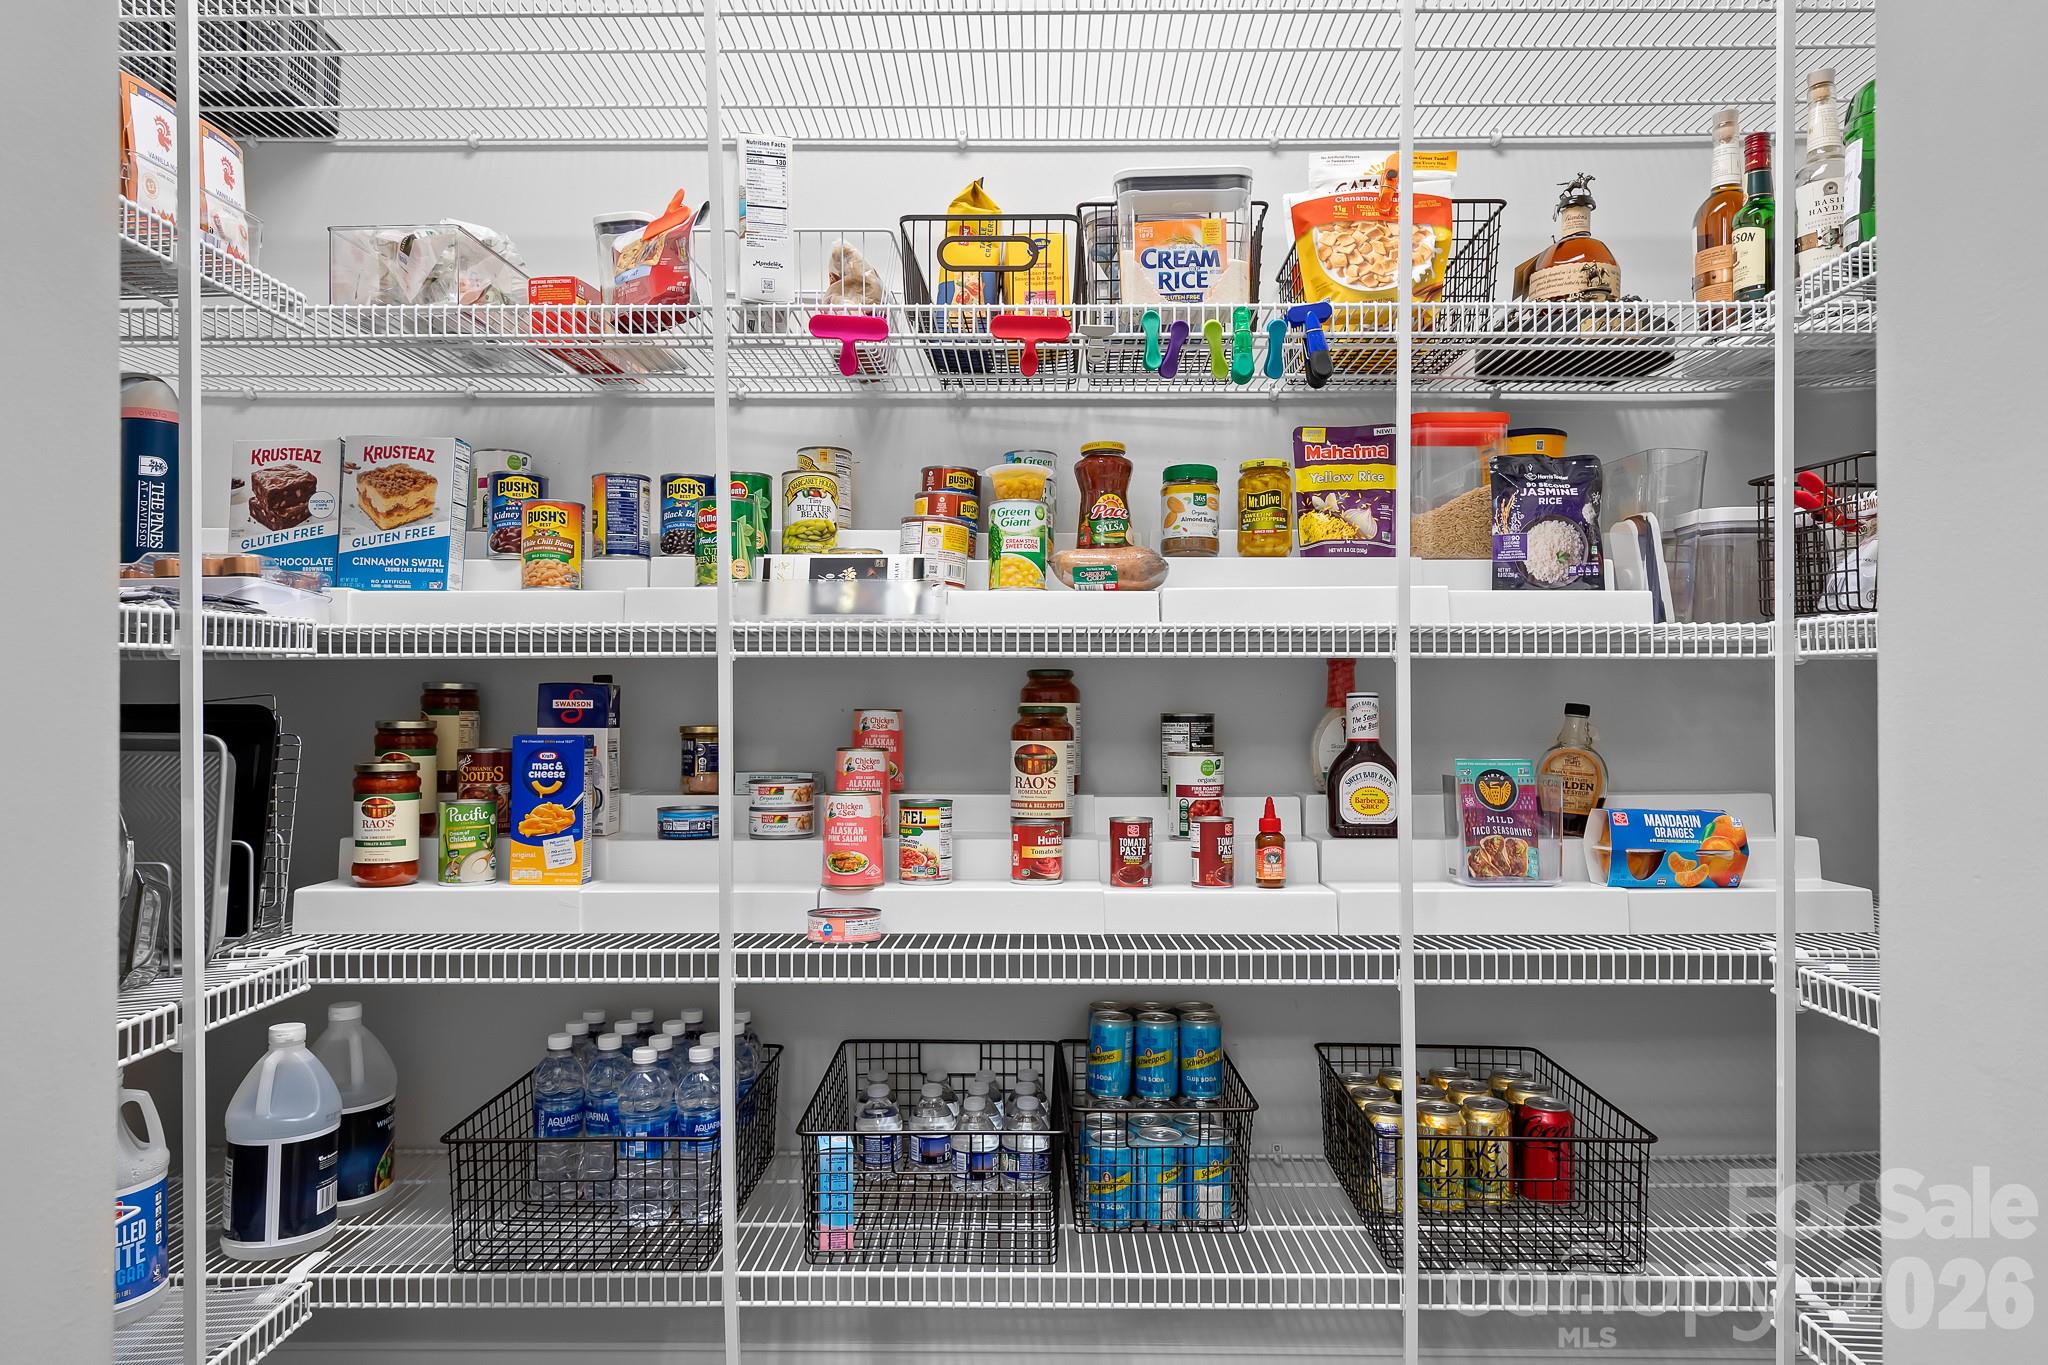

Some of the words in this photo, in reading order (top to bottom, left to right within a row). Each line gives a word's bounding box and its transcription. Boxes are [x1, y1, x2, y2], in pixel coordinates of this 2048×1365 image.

[746, 139, 770, 147] Nutrition
[1141, 248, 1220, 270] CREAM
[1158, 270, 1209, 292] RICE
[138, 408, 169, 419] owala
[251, 448, 322, 466] KRUSTEAZ
[364, 445, 435, 464] KRUSTEAZ
[1306, 444, 1388, 460] Mahatma
[1023, 457, 1052, 466] Green
[948, 475, 974, 488] BUSH'S
[1310, 472, 1353, 483] Yellow
[1358, 472, 1384, 482] Rice
[140, 480, 148, 491] AT
[499, 481, 537, 496] BUSH'S
[668, 484, 704, 496] BUSH'S
[151, 482, 165, 510] THE
[1520, 488, 1579, 496] JASMINE
[1249, 496, 1259, 507] Mt.
[1260, 493, 1280, 506] Olive
[493, 511, 520, 521] Kidney
[528, 510, 567, 524] BUSH'S
[664, 510, 683, 520] Black
[997, 508, 1030, 517] Green
[139, 500, 148, 547] DAVIDSON
[1001, 517, 1031, 527] Giant
[150, 512, 164, 548] PINES
[1096, 523, 1124, 533] SALSA
[241, 532, 289, 549] GLUTEN
[294, 525, 324, 540] FREE
[352, 532, 400, 548] GLUTEN
[404, 526, 436, 539] FREE
[555, 540, 573, 548] Beans
[704, 547, 717, 556] CUT
[352, 557, 409, 566] CINNAMON
[411, 558, 444, 568] SWIRL
[1350, 702, 1360, 712] SWEET
[1352, 716, 1362, 725] The
[1363, 713, 1377, 722] Sauce
[1352, 725, 1357, 733] is
[1358, 723, 1367, 732] the
[552, 762, 563, 770] &
[461, 766, 504, 782] SOUPS
[1015, 776, 1056, 789] RAO'S
[1345, 772, 1362, 787] SWEET
[1378, 774, 1393, 788] RAY'S
[446, 806, 489, 822] Pacific
[362, 820, 395, 828] RAO'S
[1644, 814, 1701, 828] MANDARIN
[831, 826, 864, 835] ALASKAN
[1472, 826, 1490, 835] TACO
[1492, 826, 1532, 836] SEASONING
[1655, 827, 1694, 838] ORANGES
[1119, 838, 1146, 847] TOMATO
[1120, 846, 1146, 856] PASTE
[1186, 1055, 1219, 1068] Schweppes
